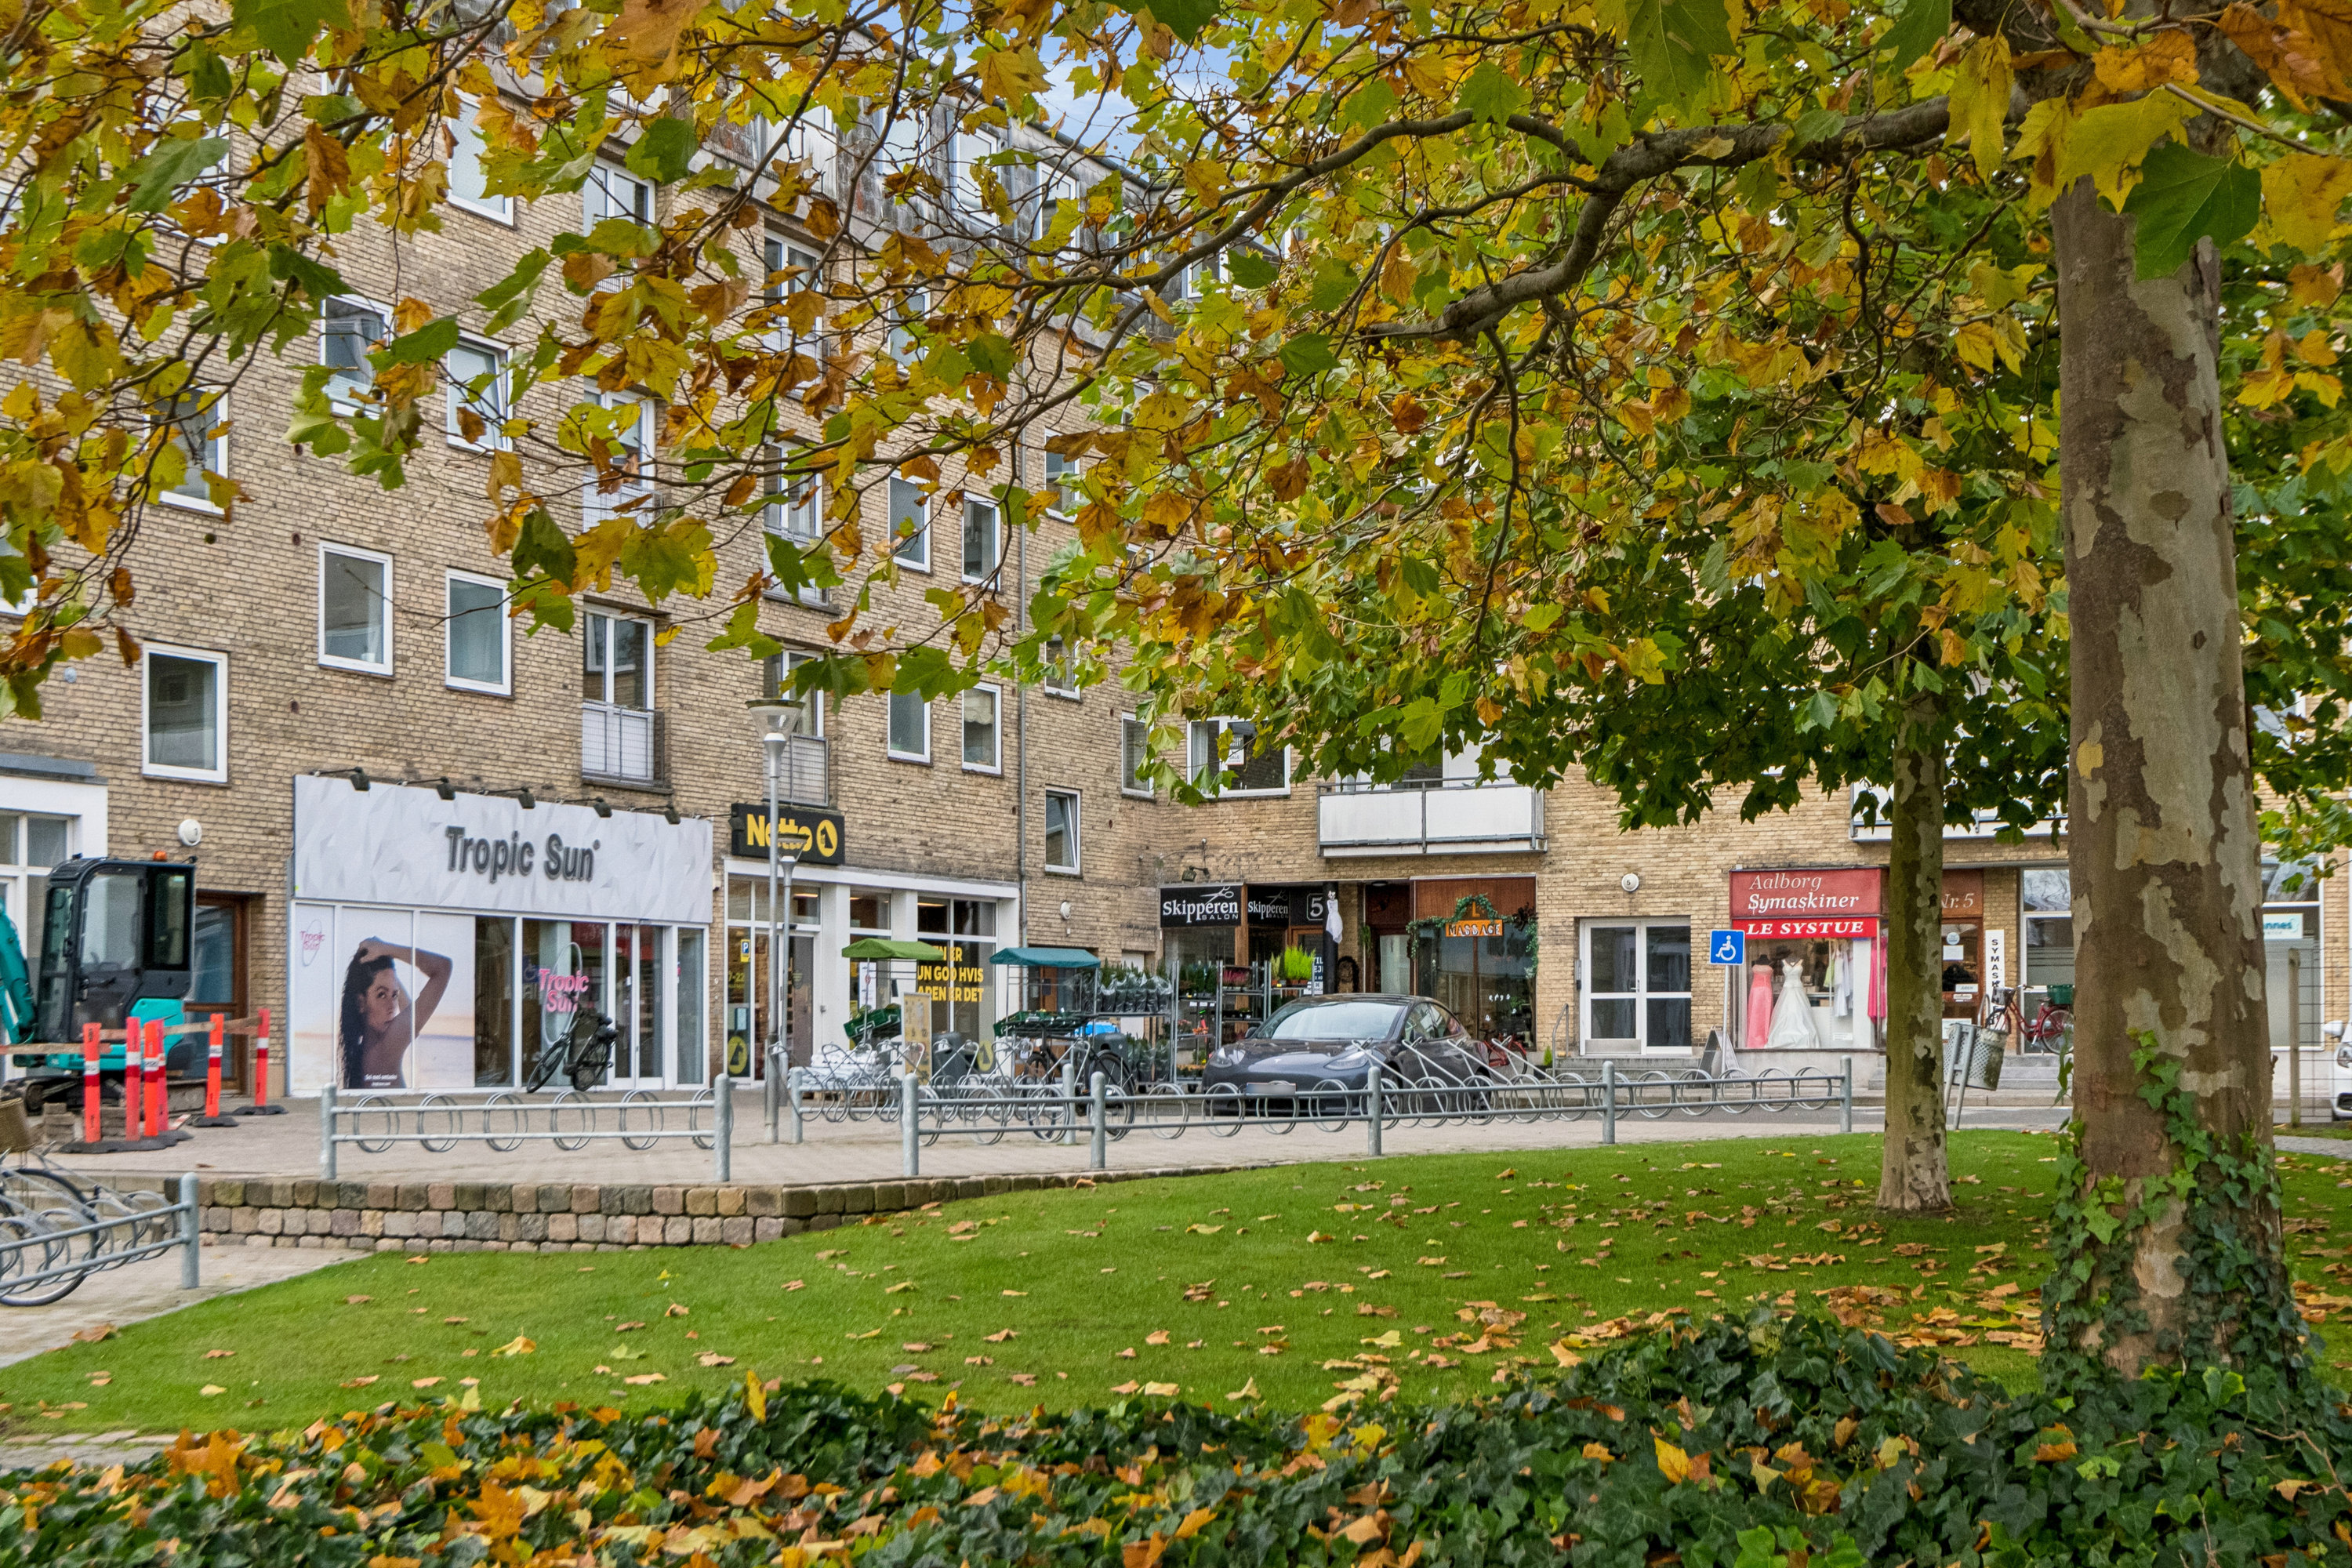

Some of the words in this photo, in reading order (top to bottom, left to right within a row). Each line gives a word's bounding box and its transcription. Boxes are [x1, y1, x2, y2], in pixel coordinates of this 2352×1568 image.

[445, 826, 535, 884] Tropic
[1749, 873, 1822, 891] Aalborg
[1310, 897, 1323, 917] 5
[1748, 891, 1859, 914] Symaskiner
[1962, 893, 1974, 909] 5
[1163, 900, 1238, 923] Skipperen
[1248, 901, 1288, 920] Skipperen
[1449, 924, 1501, 936] MASSAGE
[1746, 924, 1773, 935] LE
[1780, 921, 1864, 935] SYSTUE
[299, 931, 325, 942] Tropic
[742, 942, 749, 953] P
[949, 947, 963, 961] ER
[539, 968, 589, 992] Tropic
[934, 966, 957, 981] GOD
[959, 967, 984, 982] HVIS
[949, 987, 962, 1001] ER
[964, 987, 984, 1002] DET
